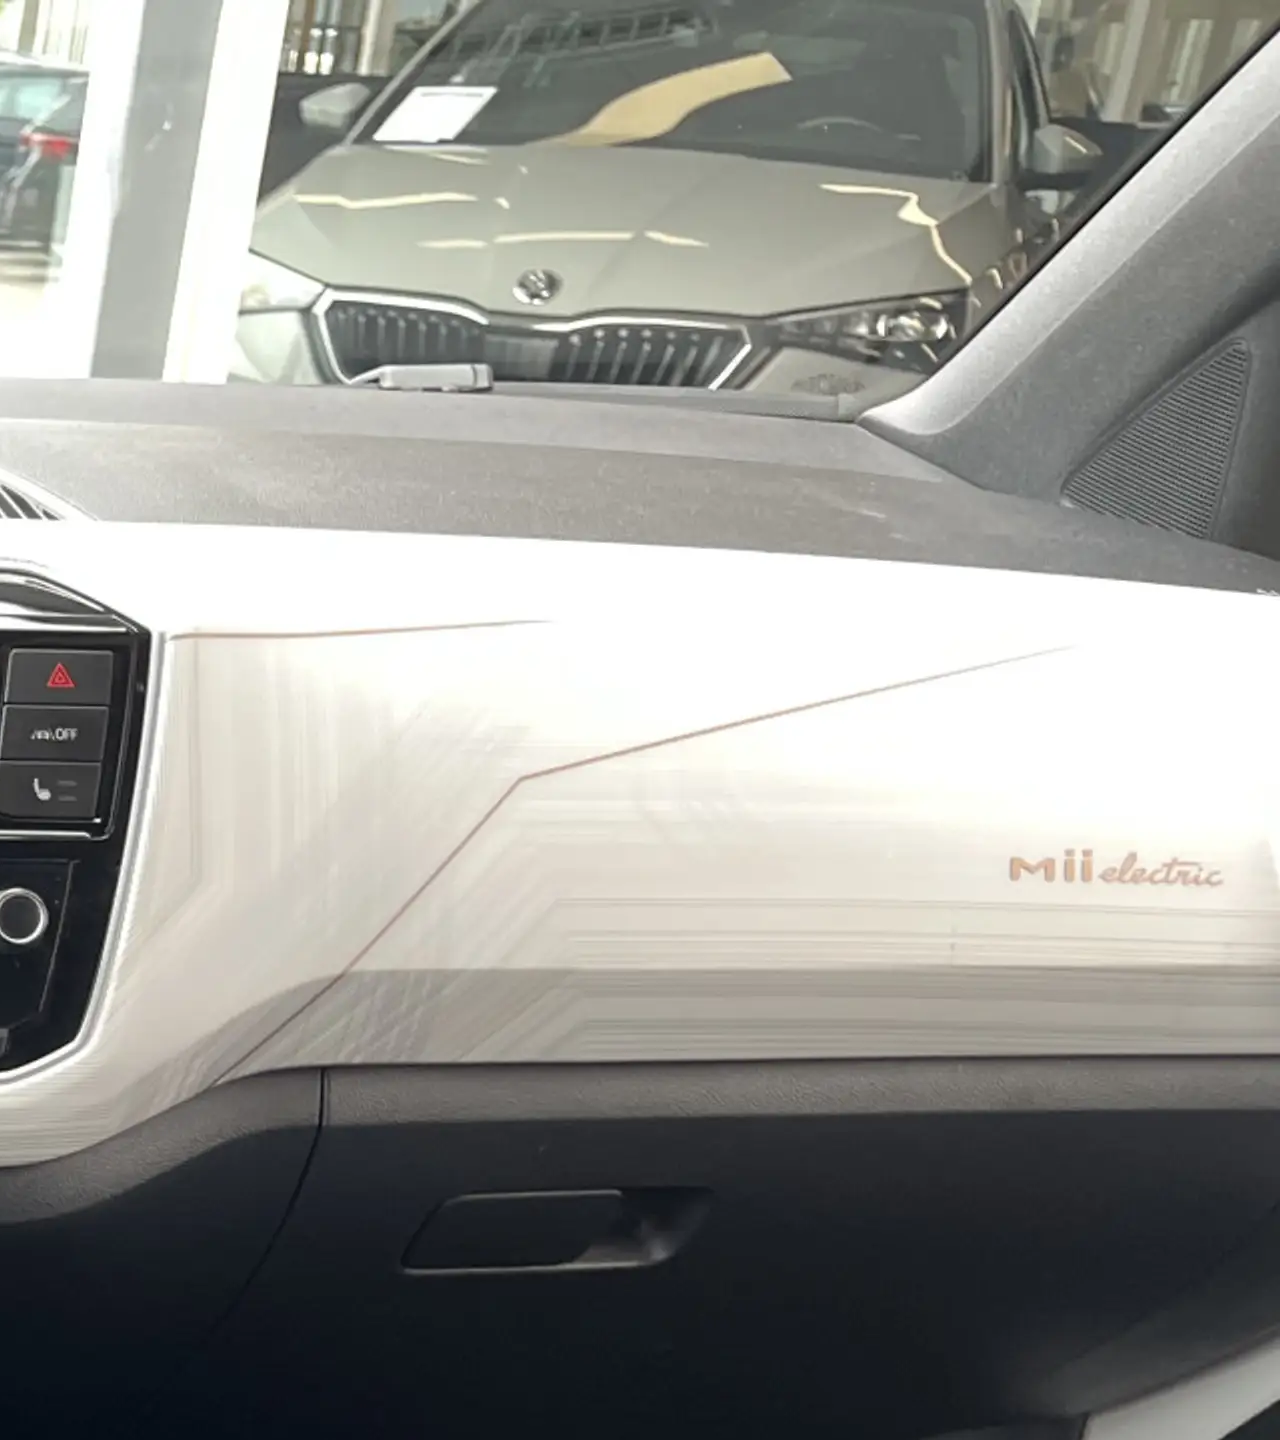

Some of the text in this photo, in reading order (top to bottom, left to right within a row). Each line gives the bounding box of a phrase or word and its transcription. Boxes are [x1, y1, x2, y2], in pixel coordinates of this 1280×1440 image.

[56, 728, 78, 741] OFF
[1009, 848, 1224, 887] Mii electric
